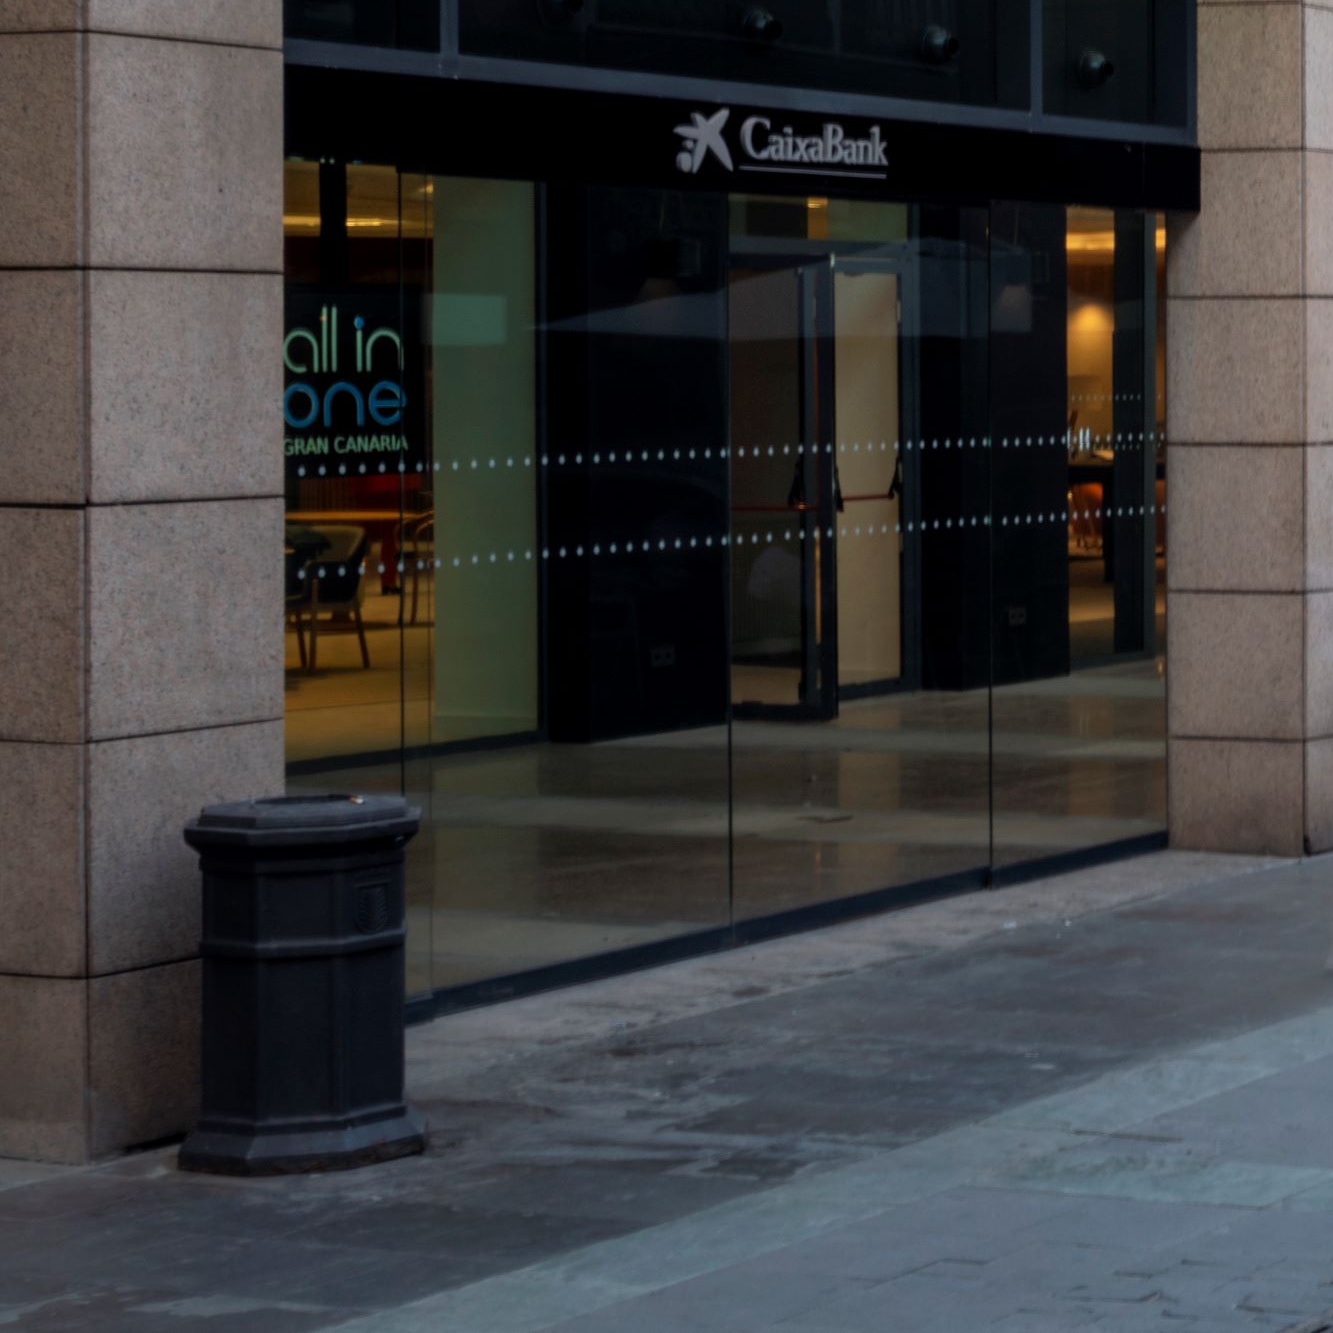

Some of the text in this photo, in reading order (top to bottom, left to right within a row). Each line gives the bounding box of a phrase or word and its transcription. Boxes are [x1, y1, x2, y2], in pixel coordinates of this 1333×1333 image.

[740, 116, 889, 166] CaixaBank
[284, 303, 404, 374] all in
[284, 380, 407, 428] one
[284, 434, 409, 456] GRAN CANARIA
